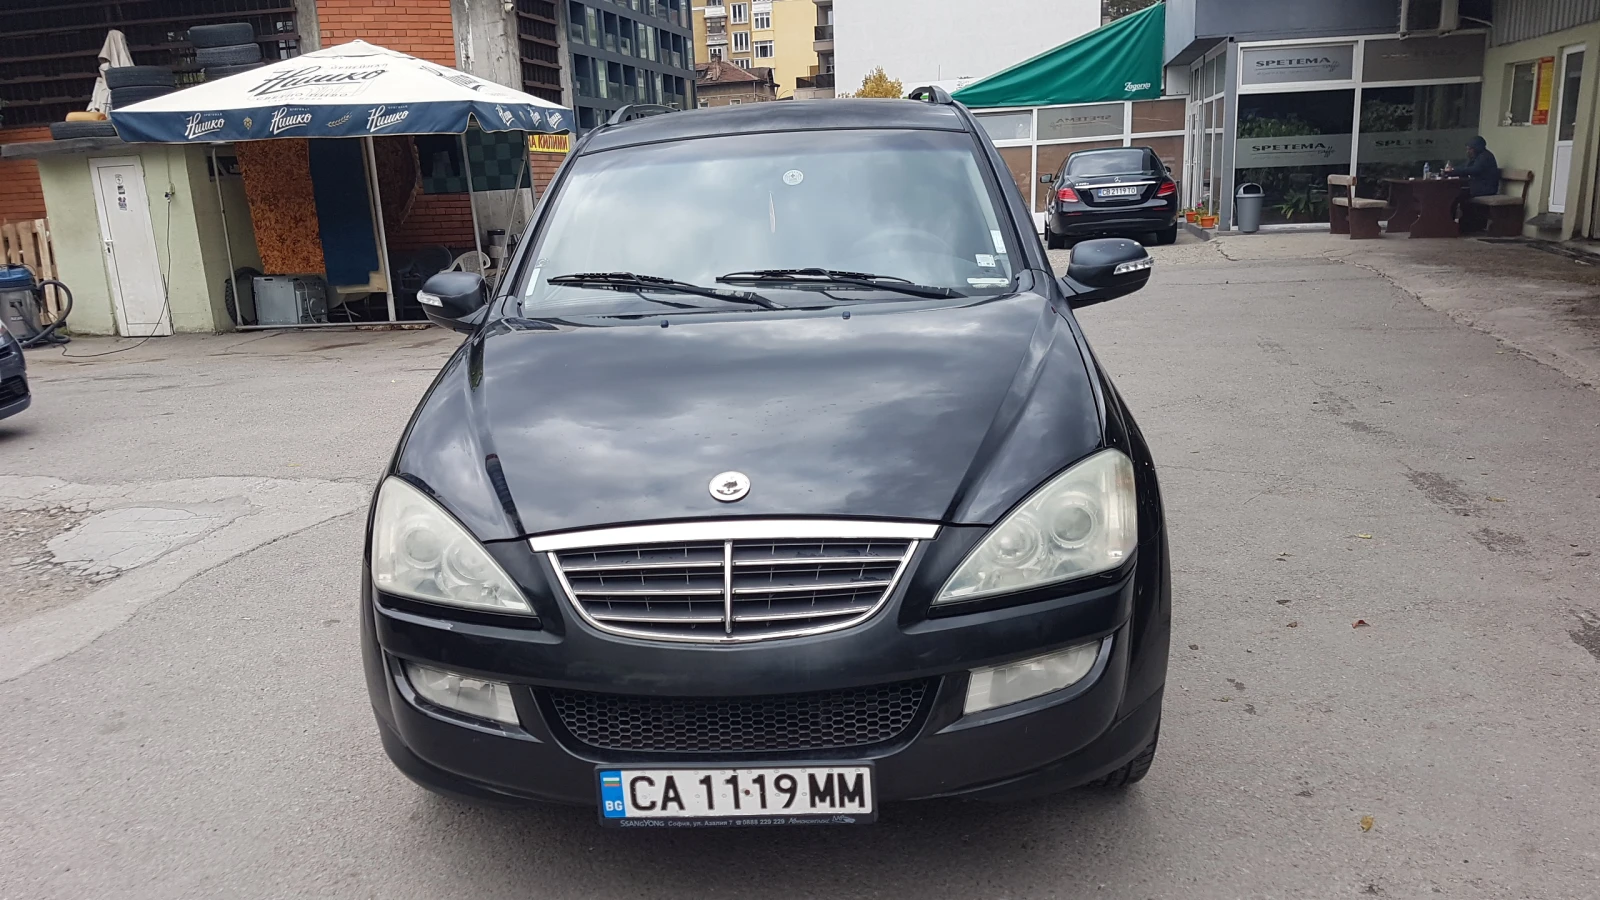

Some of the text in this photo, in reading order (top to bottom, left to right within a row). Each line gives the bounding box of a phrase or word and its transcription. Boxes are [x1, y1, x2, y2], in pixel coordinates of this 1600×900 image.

[1256, 57, 1331, 67] SPETEMA
[269, 106, 312, 135] Нишко
[366, 104, 409, 133] Нишко
[184, 112, 225, 139] Нишко
[538, 135, 568, 150] КИЛИМИ
[1251, 142, 1326, 151] SPETEMA
[1111, 187, 1126, 195] 2119
[629, 772, 865, 811] CA 1119 MM
[605, 800, 623, 811] BG
[668, 820, 692, 828] София,
